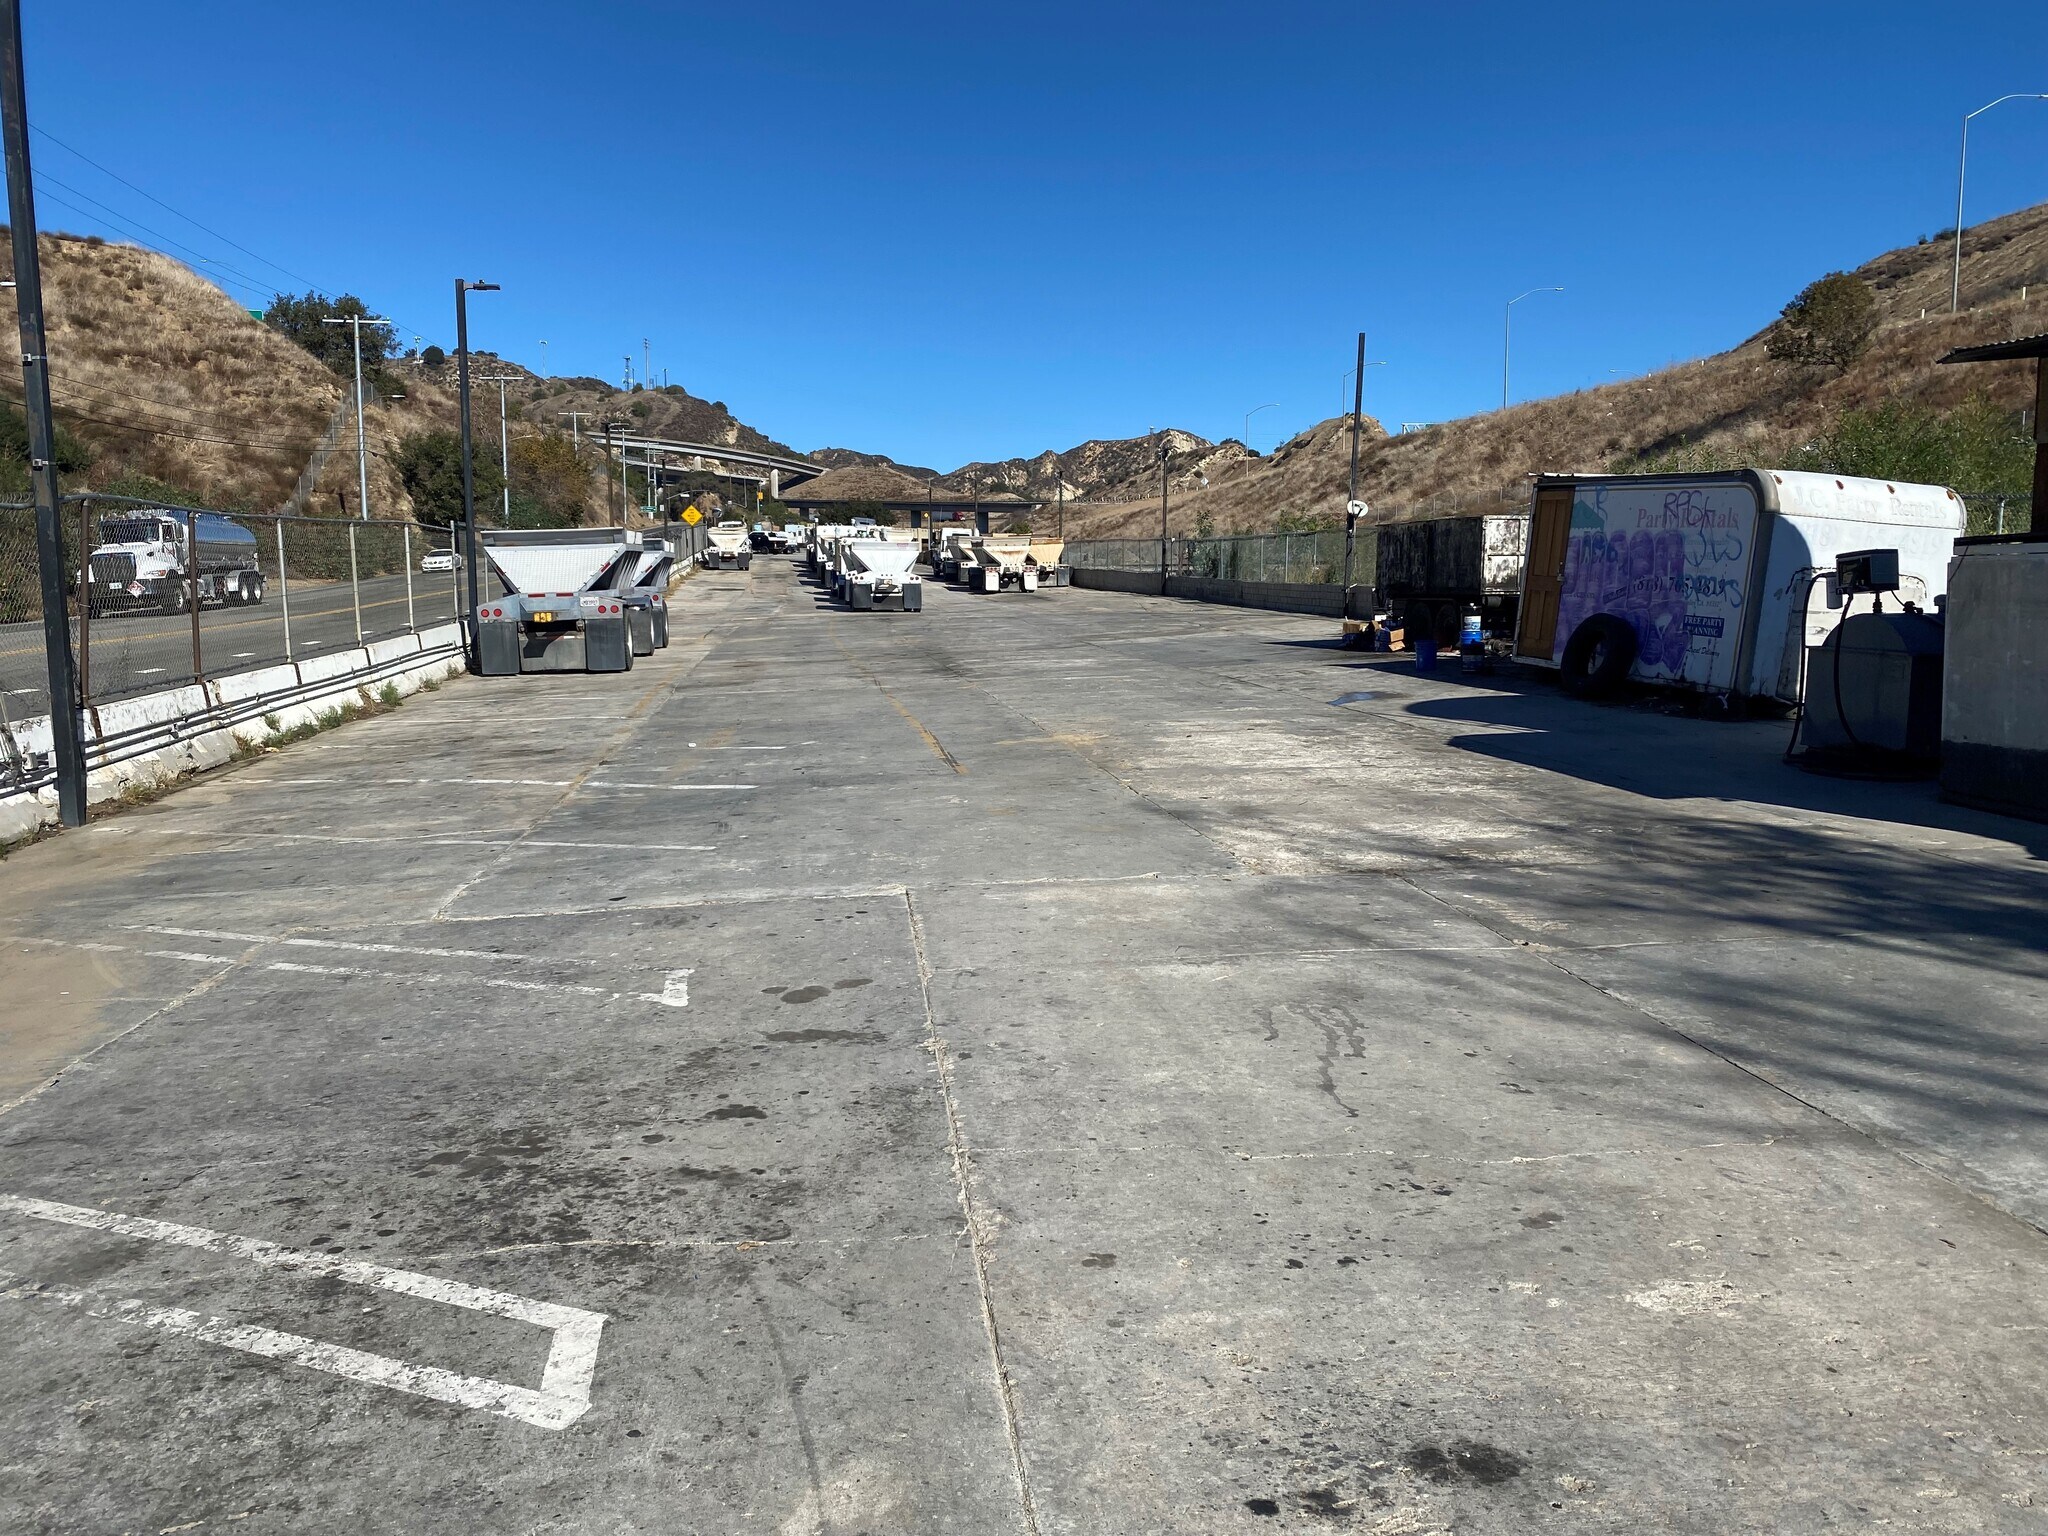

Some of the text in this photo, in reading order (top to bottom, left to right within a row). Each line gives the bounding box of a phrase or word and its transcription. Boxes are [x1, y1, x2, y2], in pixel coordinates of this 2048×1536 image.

[1636, 506, 1740, 530] Party Rentals
[1888, 497, 1949, 521] Rentals
[1684, 616, 1722, 627] FREE PARTY
